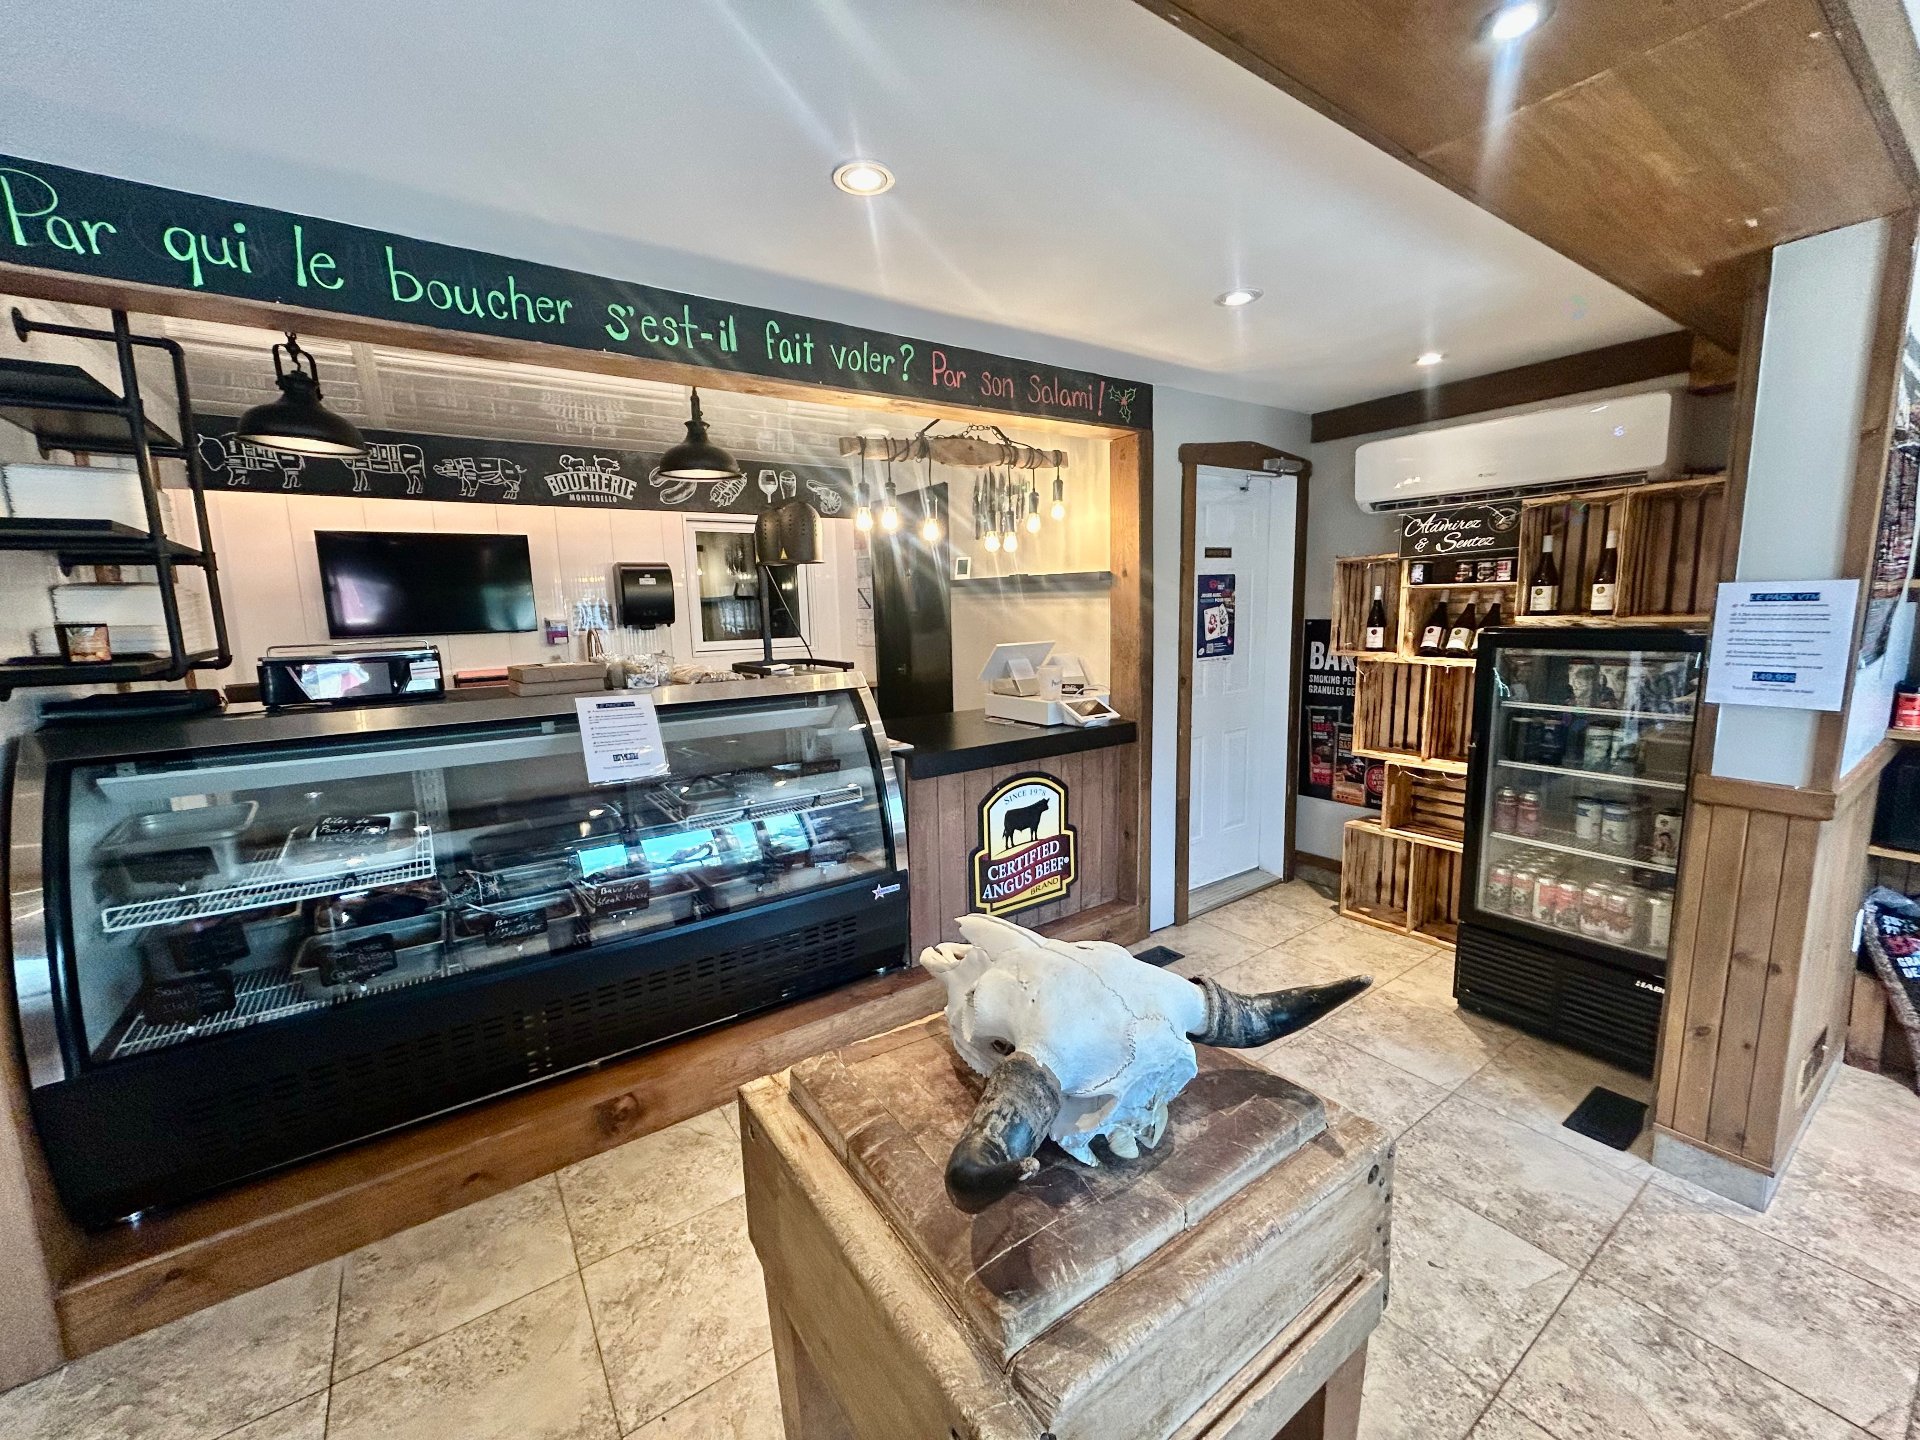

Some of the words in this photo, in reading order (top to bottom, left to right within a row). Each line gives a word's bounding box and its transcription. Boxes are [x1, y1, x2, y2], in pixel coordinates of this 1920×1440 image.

[0, 167, 117, 256] Par
[163, 222, 253, 286] qui
[294, 224, 345, 290] le
[385, 245, 573, 326] boucher
[765, 319, 815, 365] fait
[829, 341, 915, 382] voler?
[932, 350, 966, 388] Par
[980, 371, 1014, 399] son
[1027, 374, 1106, 417] Salami!
[545, 472, 637, 499] BOUCHERIE
[569, 493, 618, 503] MONTEBELLO
[1404, 513, 1482, 537] Admirez
[1414, 537, 1429, 553] &
[1435, 531, 1495, 552] Sentez
[1308, 685, 1345, 696] GRANULES
[1309, 674, 1341, 685] SMOKING
[1003, 789, 1027, 806] SINCE
[1029, 788, 1047, 797] 1978
[987, 840, 1060, 882] CERTIFIED
[982, 868, 1033, 900] ANGUS
[1030, 877, 1060, 896] BRAND
